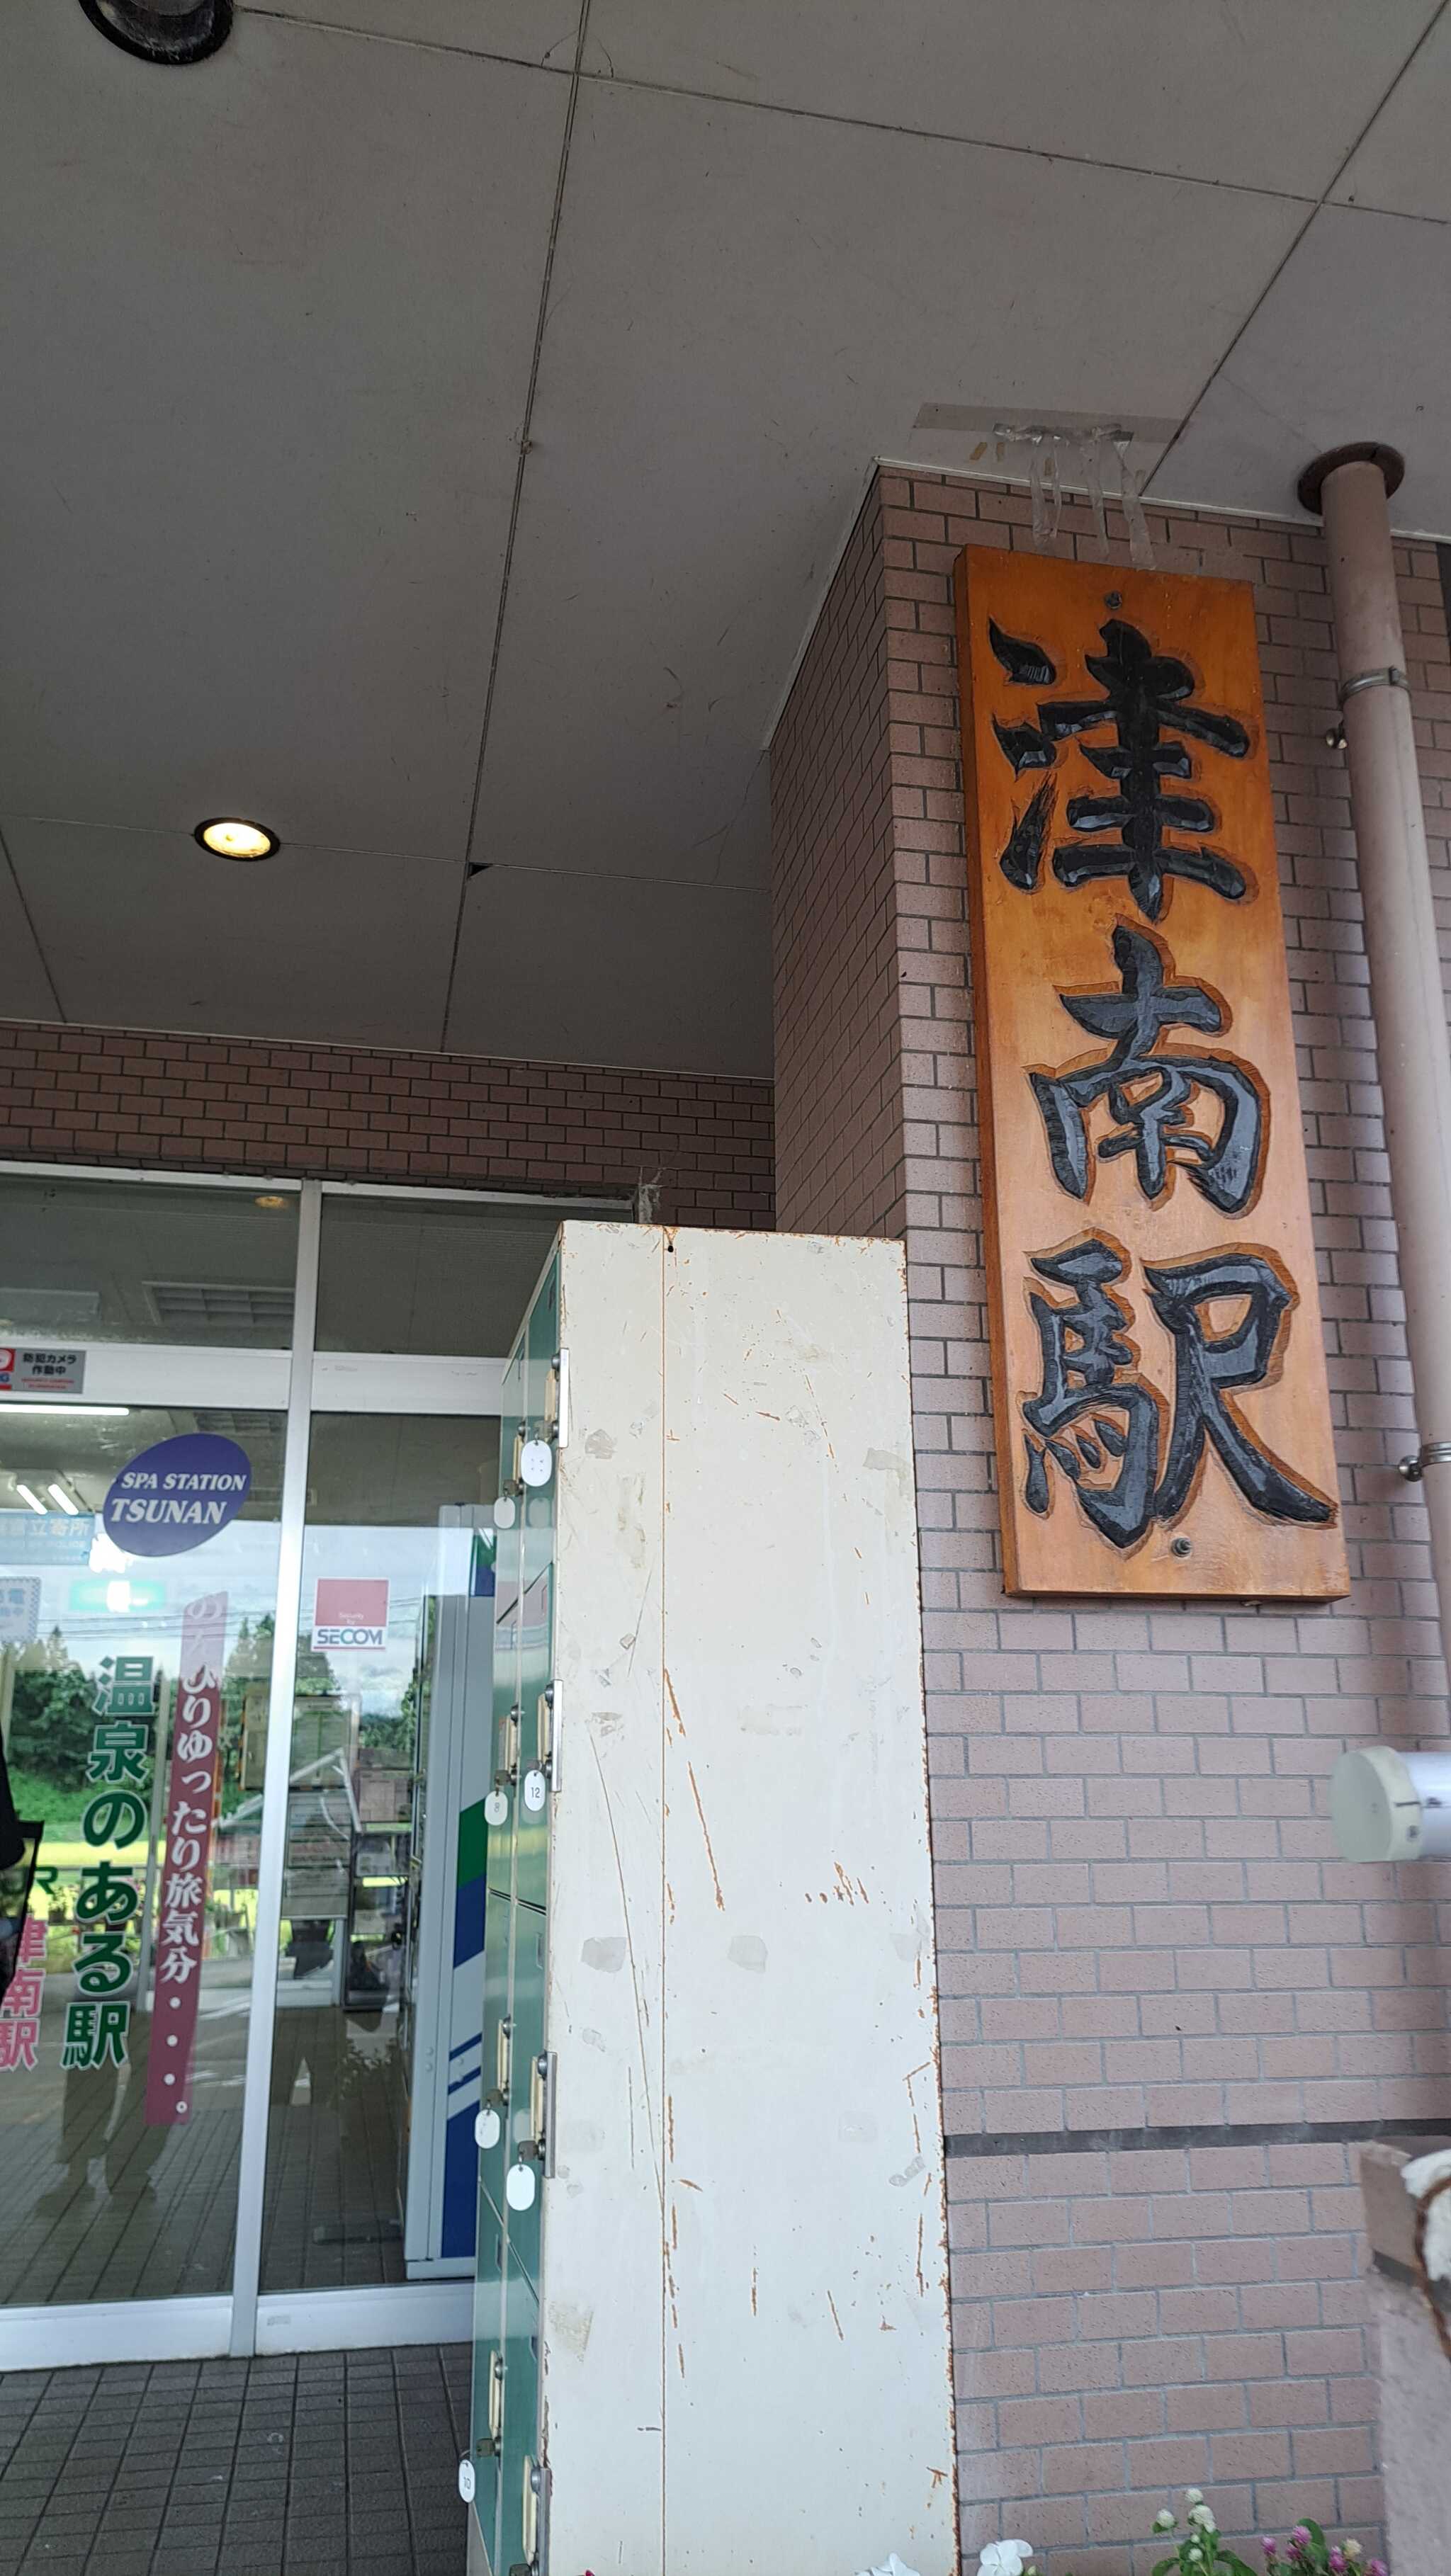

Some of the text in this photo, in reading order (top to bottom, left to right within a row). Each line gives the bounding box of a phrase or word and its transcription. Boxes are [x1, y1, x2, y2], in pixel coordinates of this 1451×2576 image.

[988, 616, 1338, 1554] 津南駅
[23, 1352, 77, 1364] 防犯カメラ
[33, 1365, 67, 1375] 作動中
[121, 1472, 247, 1491] SPA STATION
[111, 1498, 227, 1525] TSUNAN
[317, 1628, 383, 1645] SECOM
[531, 1787, 540, 1798] 12
[60, 1655, 154, 2070] 温泉のある駅
